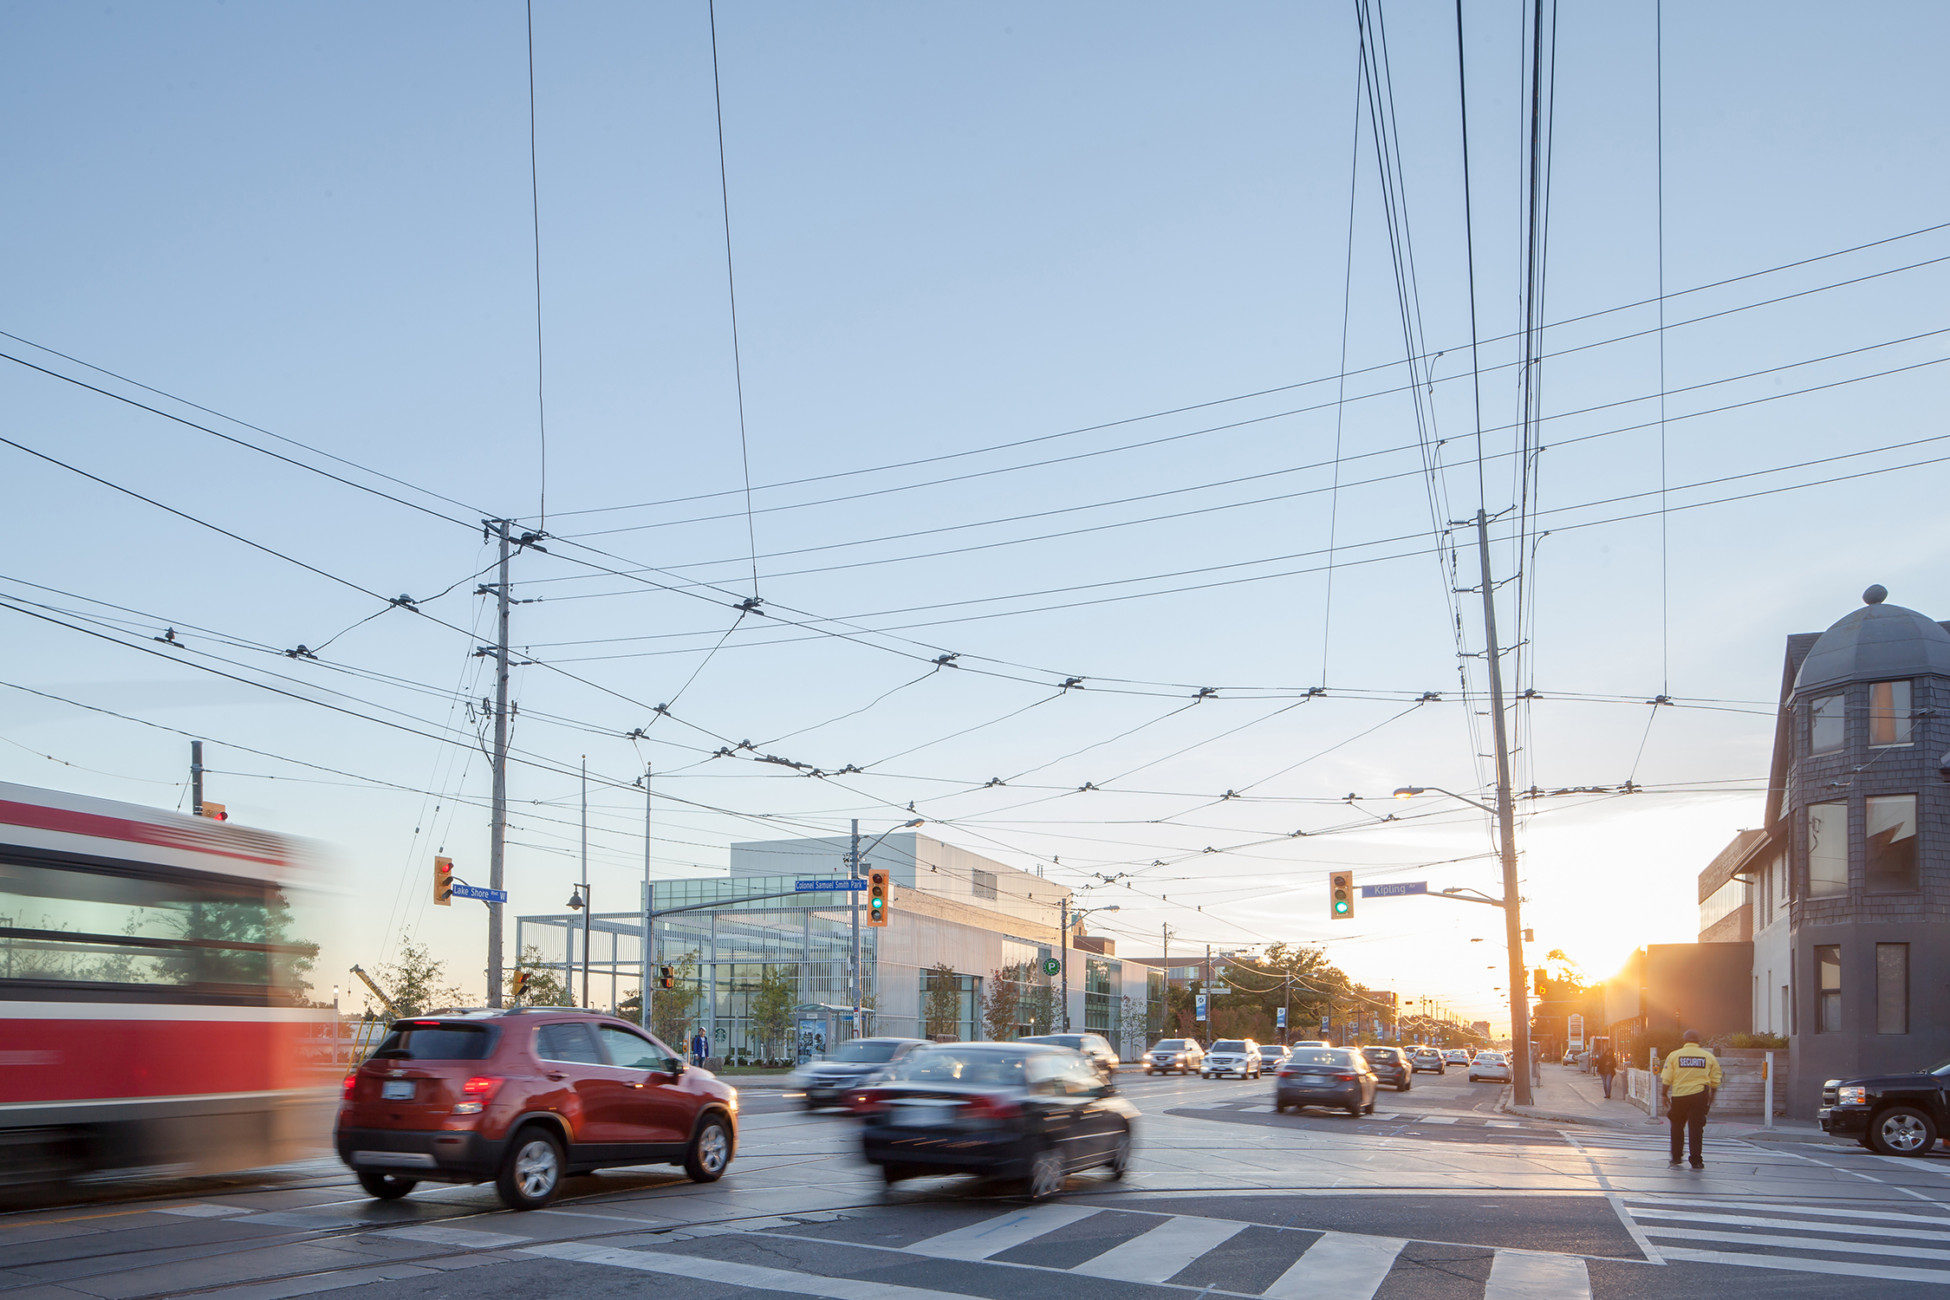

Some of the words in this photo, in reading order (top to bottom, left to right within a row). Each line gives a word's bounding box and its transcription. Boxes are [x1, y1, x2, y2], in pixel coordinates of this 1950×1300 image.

[796, 881, 814, 889] Colonel
[816, 881, 833, 889] Samuel
[836, 881, 849, 889] Smith
[851, 881, 862, 889] Park
[1375, 884, 1406, 896] Kipling
[454, 885, 469, 896] Lake
[471, 888, 489, 898] Shore
[500, 892, 506, 900] W
[1049, 962, 1056, 970] P
[1680, 1057, 1706, 1067] SECURITY
